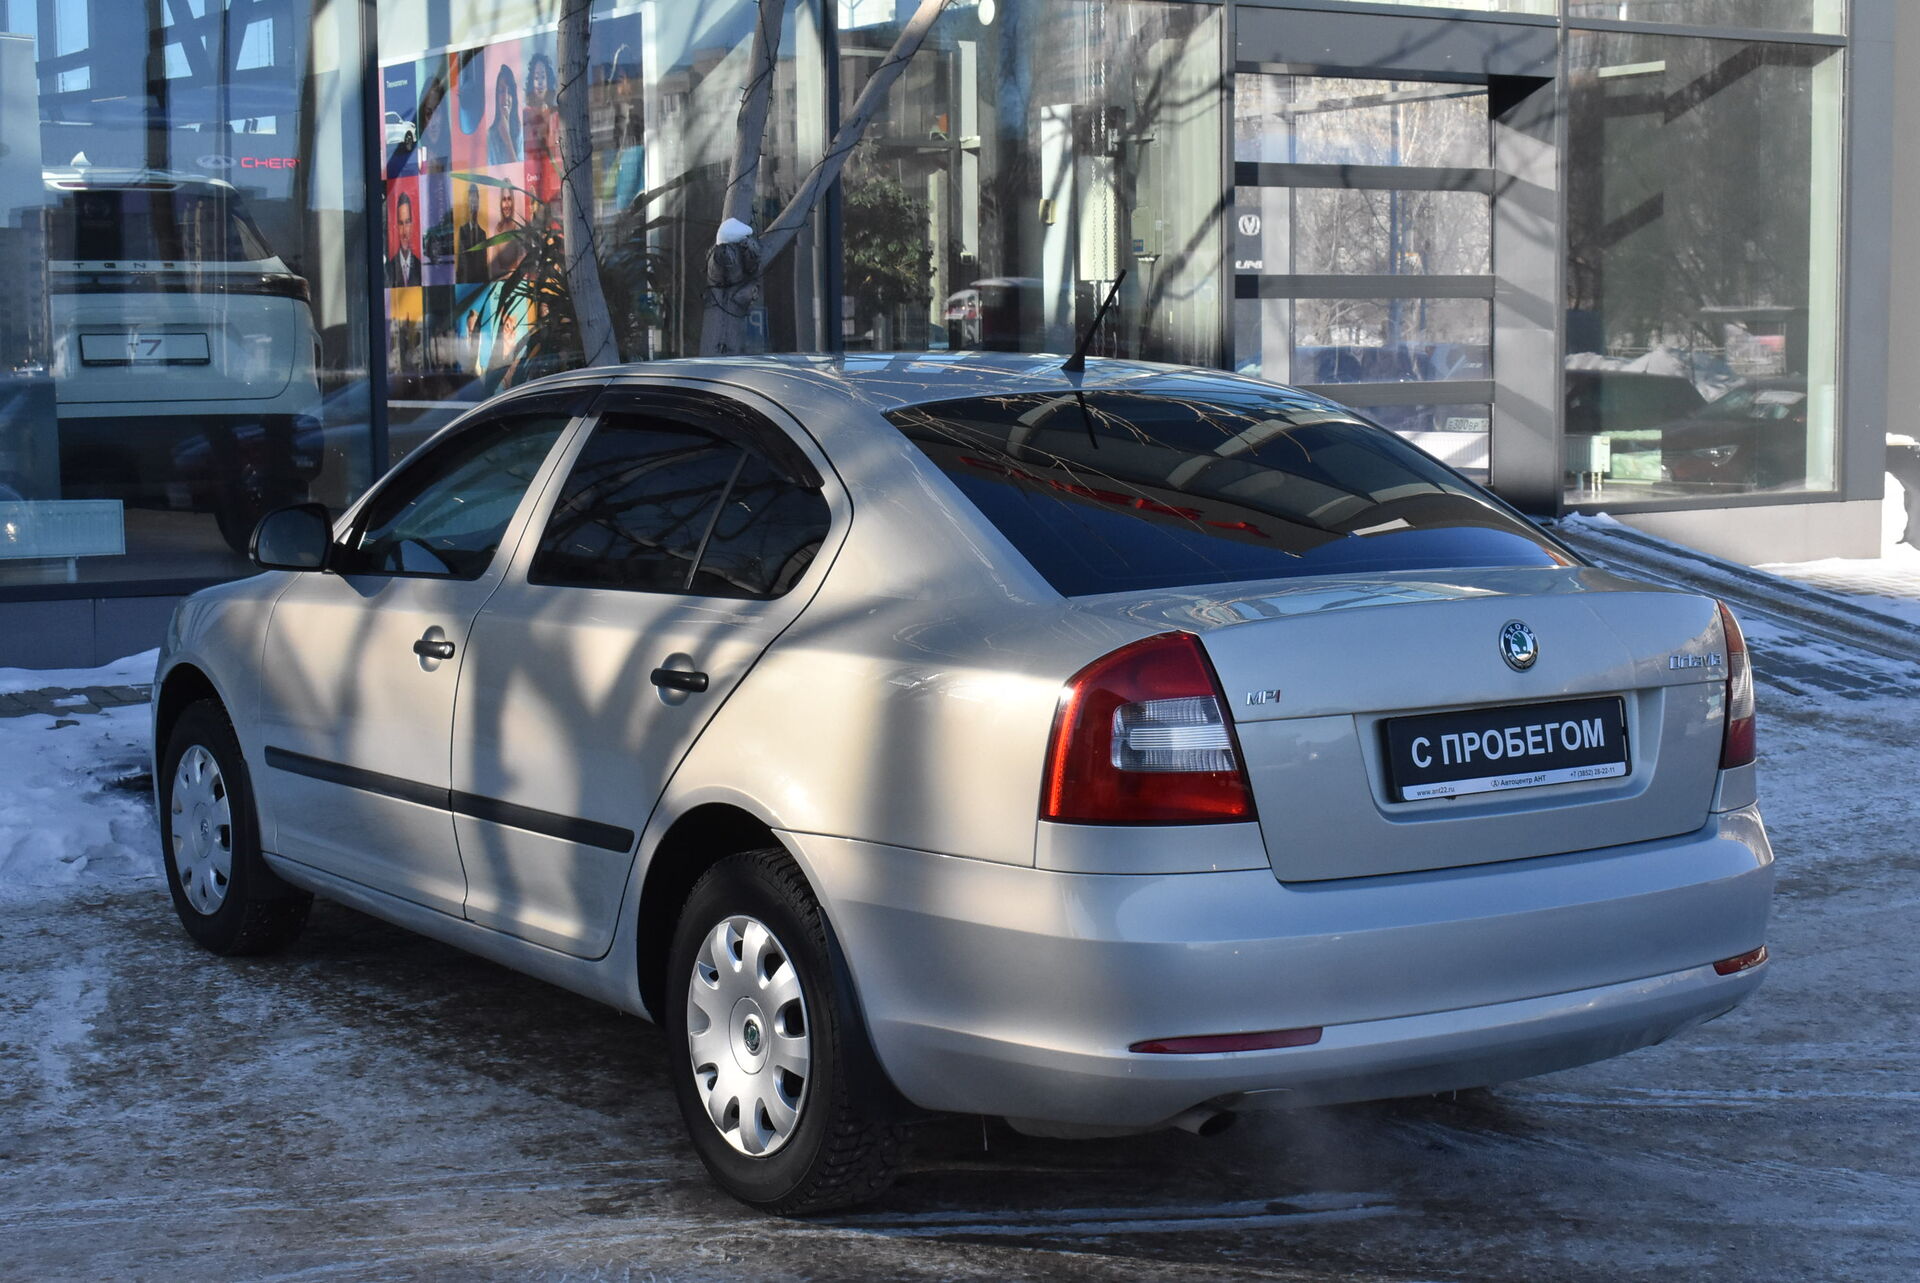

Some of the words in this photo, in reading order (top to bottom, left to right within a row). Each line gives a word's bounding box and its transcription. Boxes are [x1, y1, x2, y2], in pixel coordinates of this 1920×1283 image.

[241, 157, 300, 168] CHER
[1246, 690, 1280, 705] MPI
[1411, 736, 1432, 768] С
[1441, 718, 1605, 765] ПРОБЕГОМ
[1500, 777, 1533, 787] Автоцентр
[1534, 774, 1547, 783] АНТ
